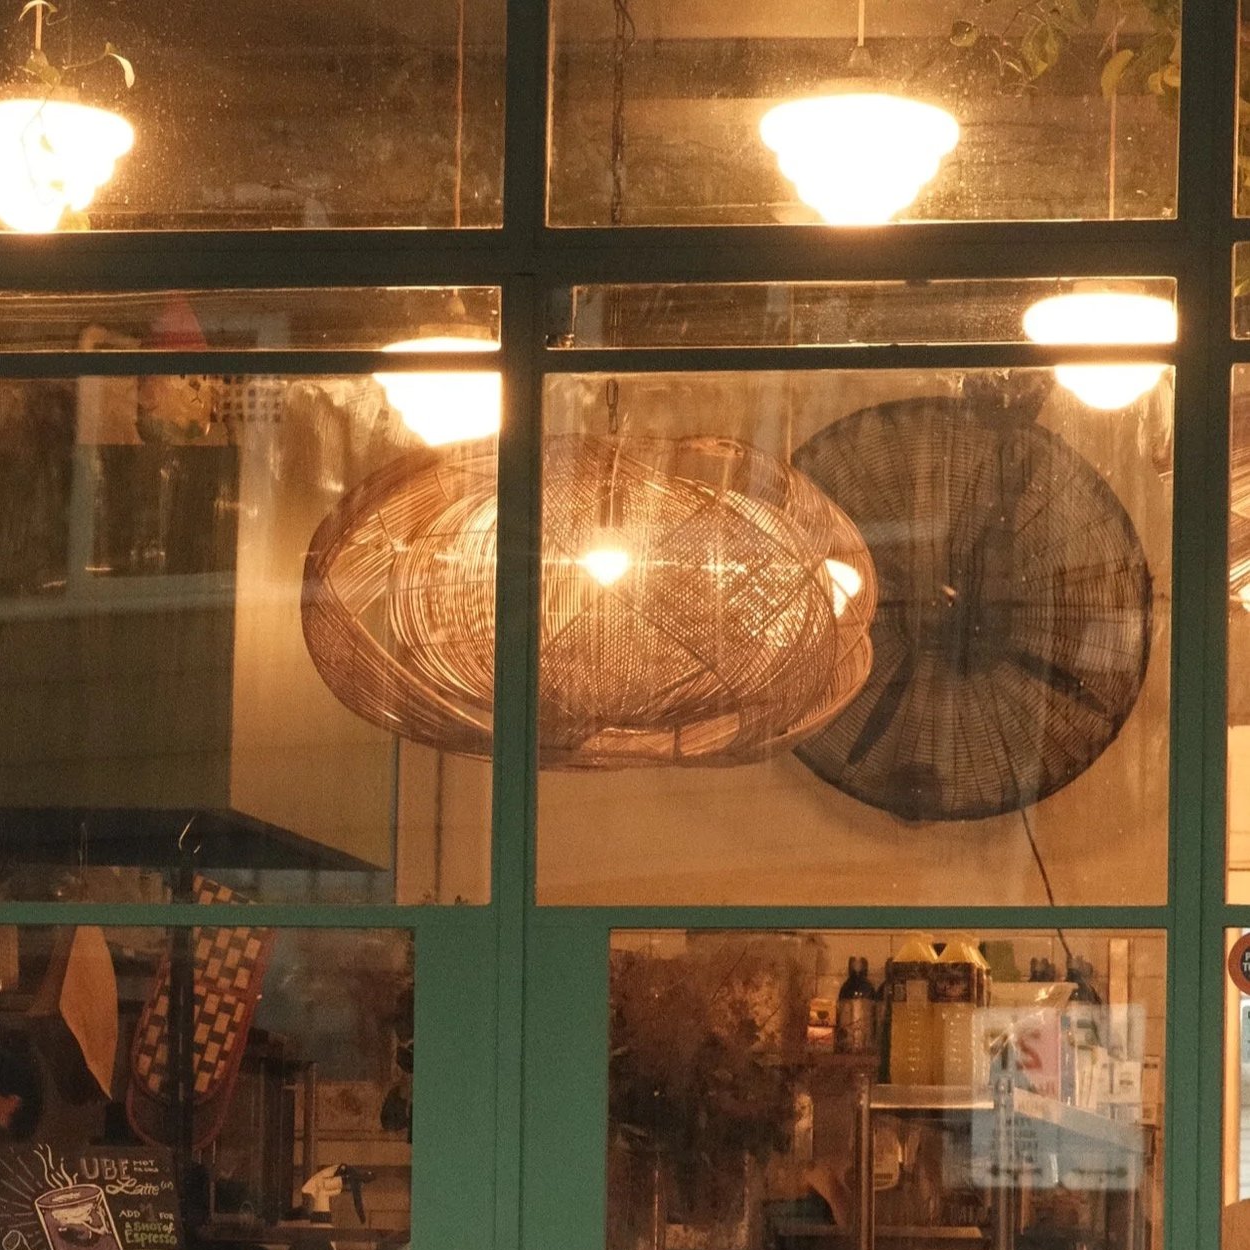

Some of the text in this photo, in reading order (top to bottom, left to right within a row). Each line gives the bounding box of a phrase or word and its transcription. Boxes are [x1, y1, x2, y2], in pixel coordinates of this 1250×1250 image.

[81, 1158, 130, 1180] UBE
[106, 1178, 159, 1195] Latte
[119, 1210, 140, 1218] ADD
[125, 1229, 177, 1247] Espresso
